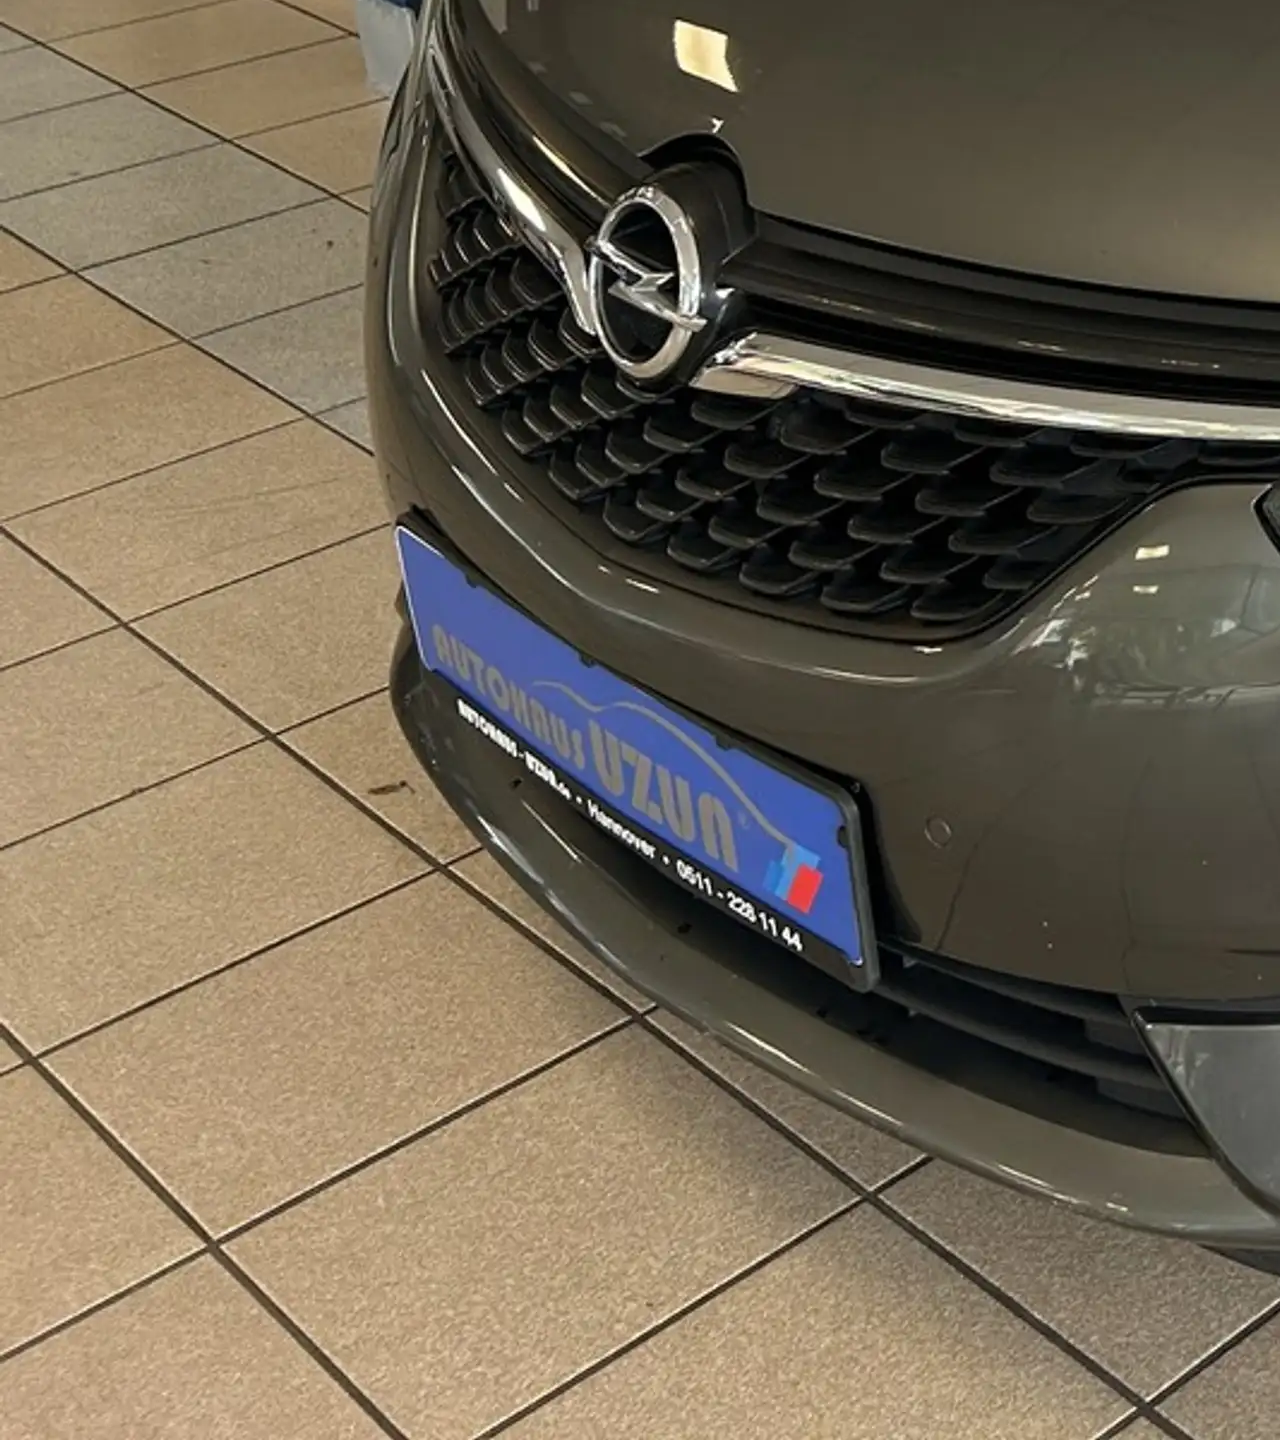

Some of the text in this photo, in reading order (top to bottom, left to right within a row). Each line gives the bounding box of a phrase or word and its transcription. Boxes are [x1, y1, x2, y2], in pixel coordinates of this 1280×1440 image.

[432, 623, 739, 873] AUTOHAUS UZUN
[587, 799, 657, 859] Hannover
[676, 859, 713, 896] 0511
[726, 891, 757, 923] 228
[759, 912, 778, 937] 11
[782, 926, 803, 952] 44
